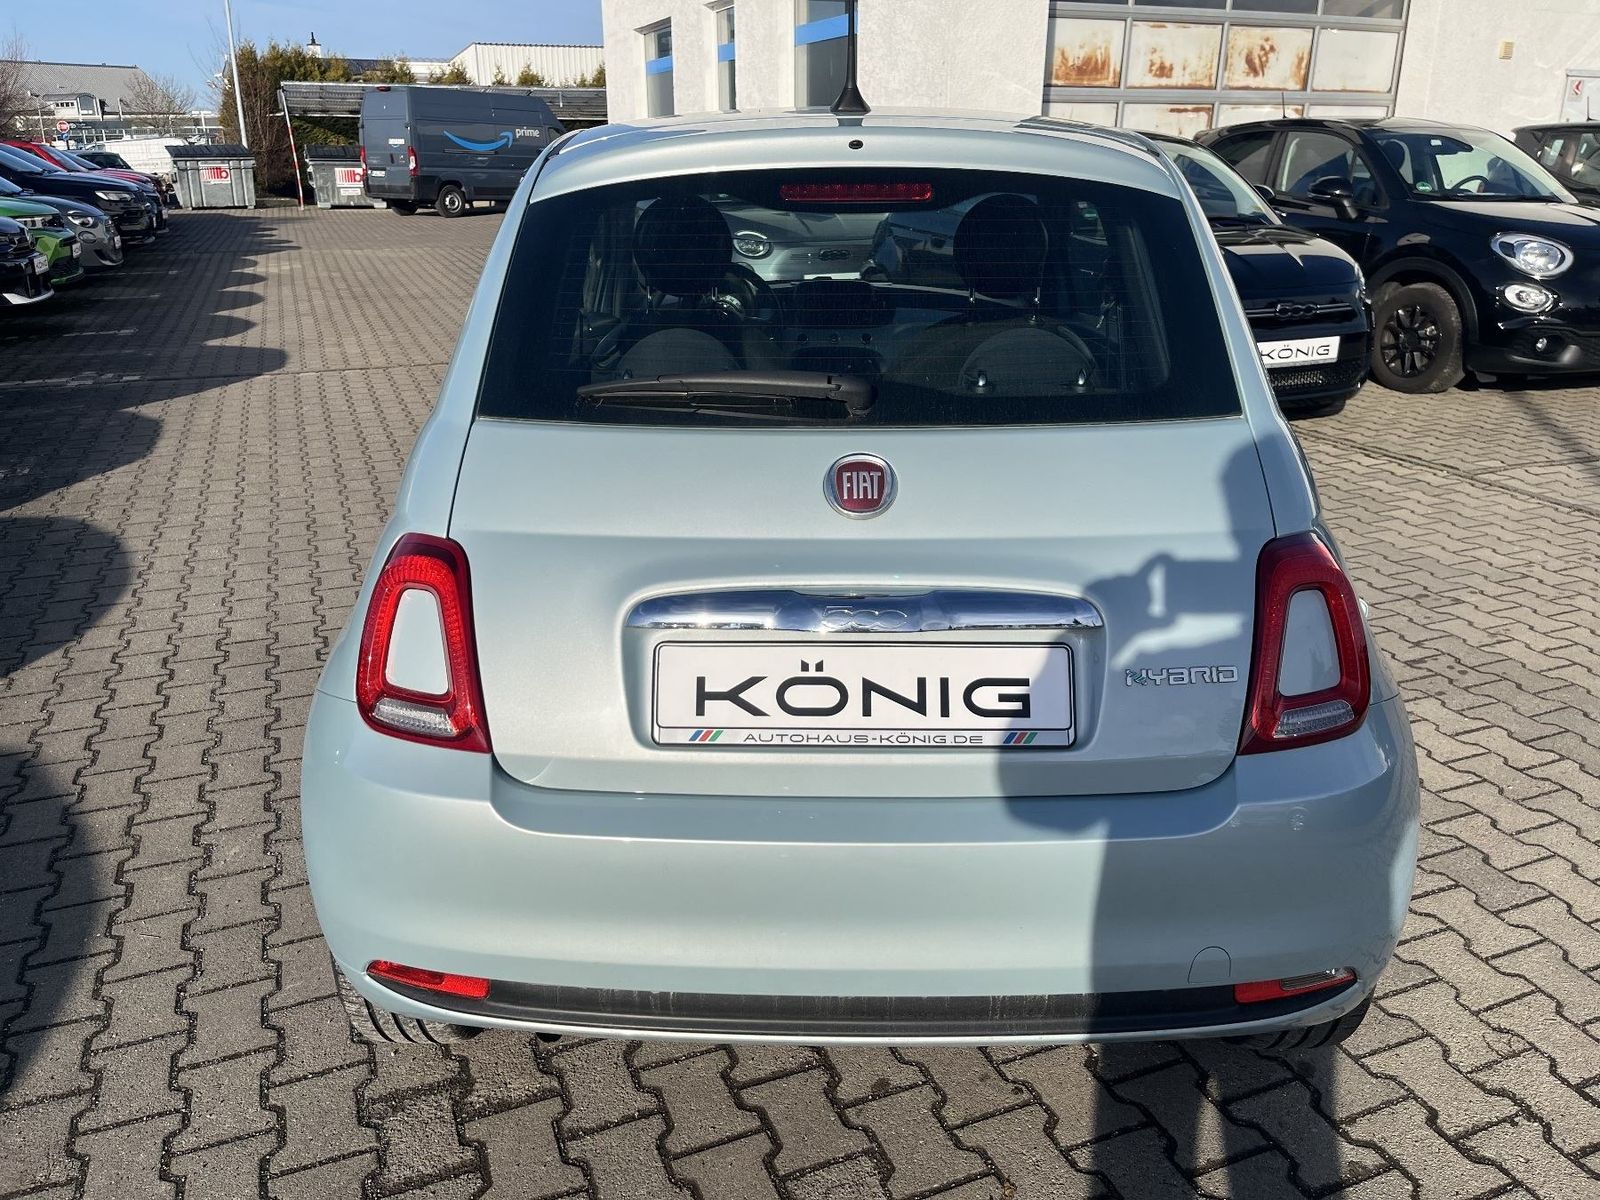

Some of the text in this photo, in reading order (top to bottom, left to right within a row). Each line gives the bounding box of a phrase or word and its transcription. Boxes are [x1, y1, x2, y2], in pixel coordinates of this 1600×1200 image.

[515, 126, 540, 139] prime
[1261, 344, 1331, 360] KÖNIG
[842, 471, 881, 500] FIAT
[821, 605, 908, 630] 500
[1126, 665, 1239, 687] HYBRID
[695, 659, 1031, 718] KÖNIG
[743, 731, 984, 745] AUTOHAUS-KÖNIG.DE
